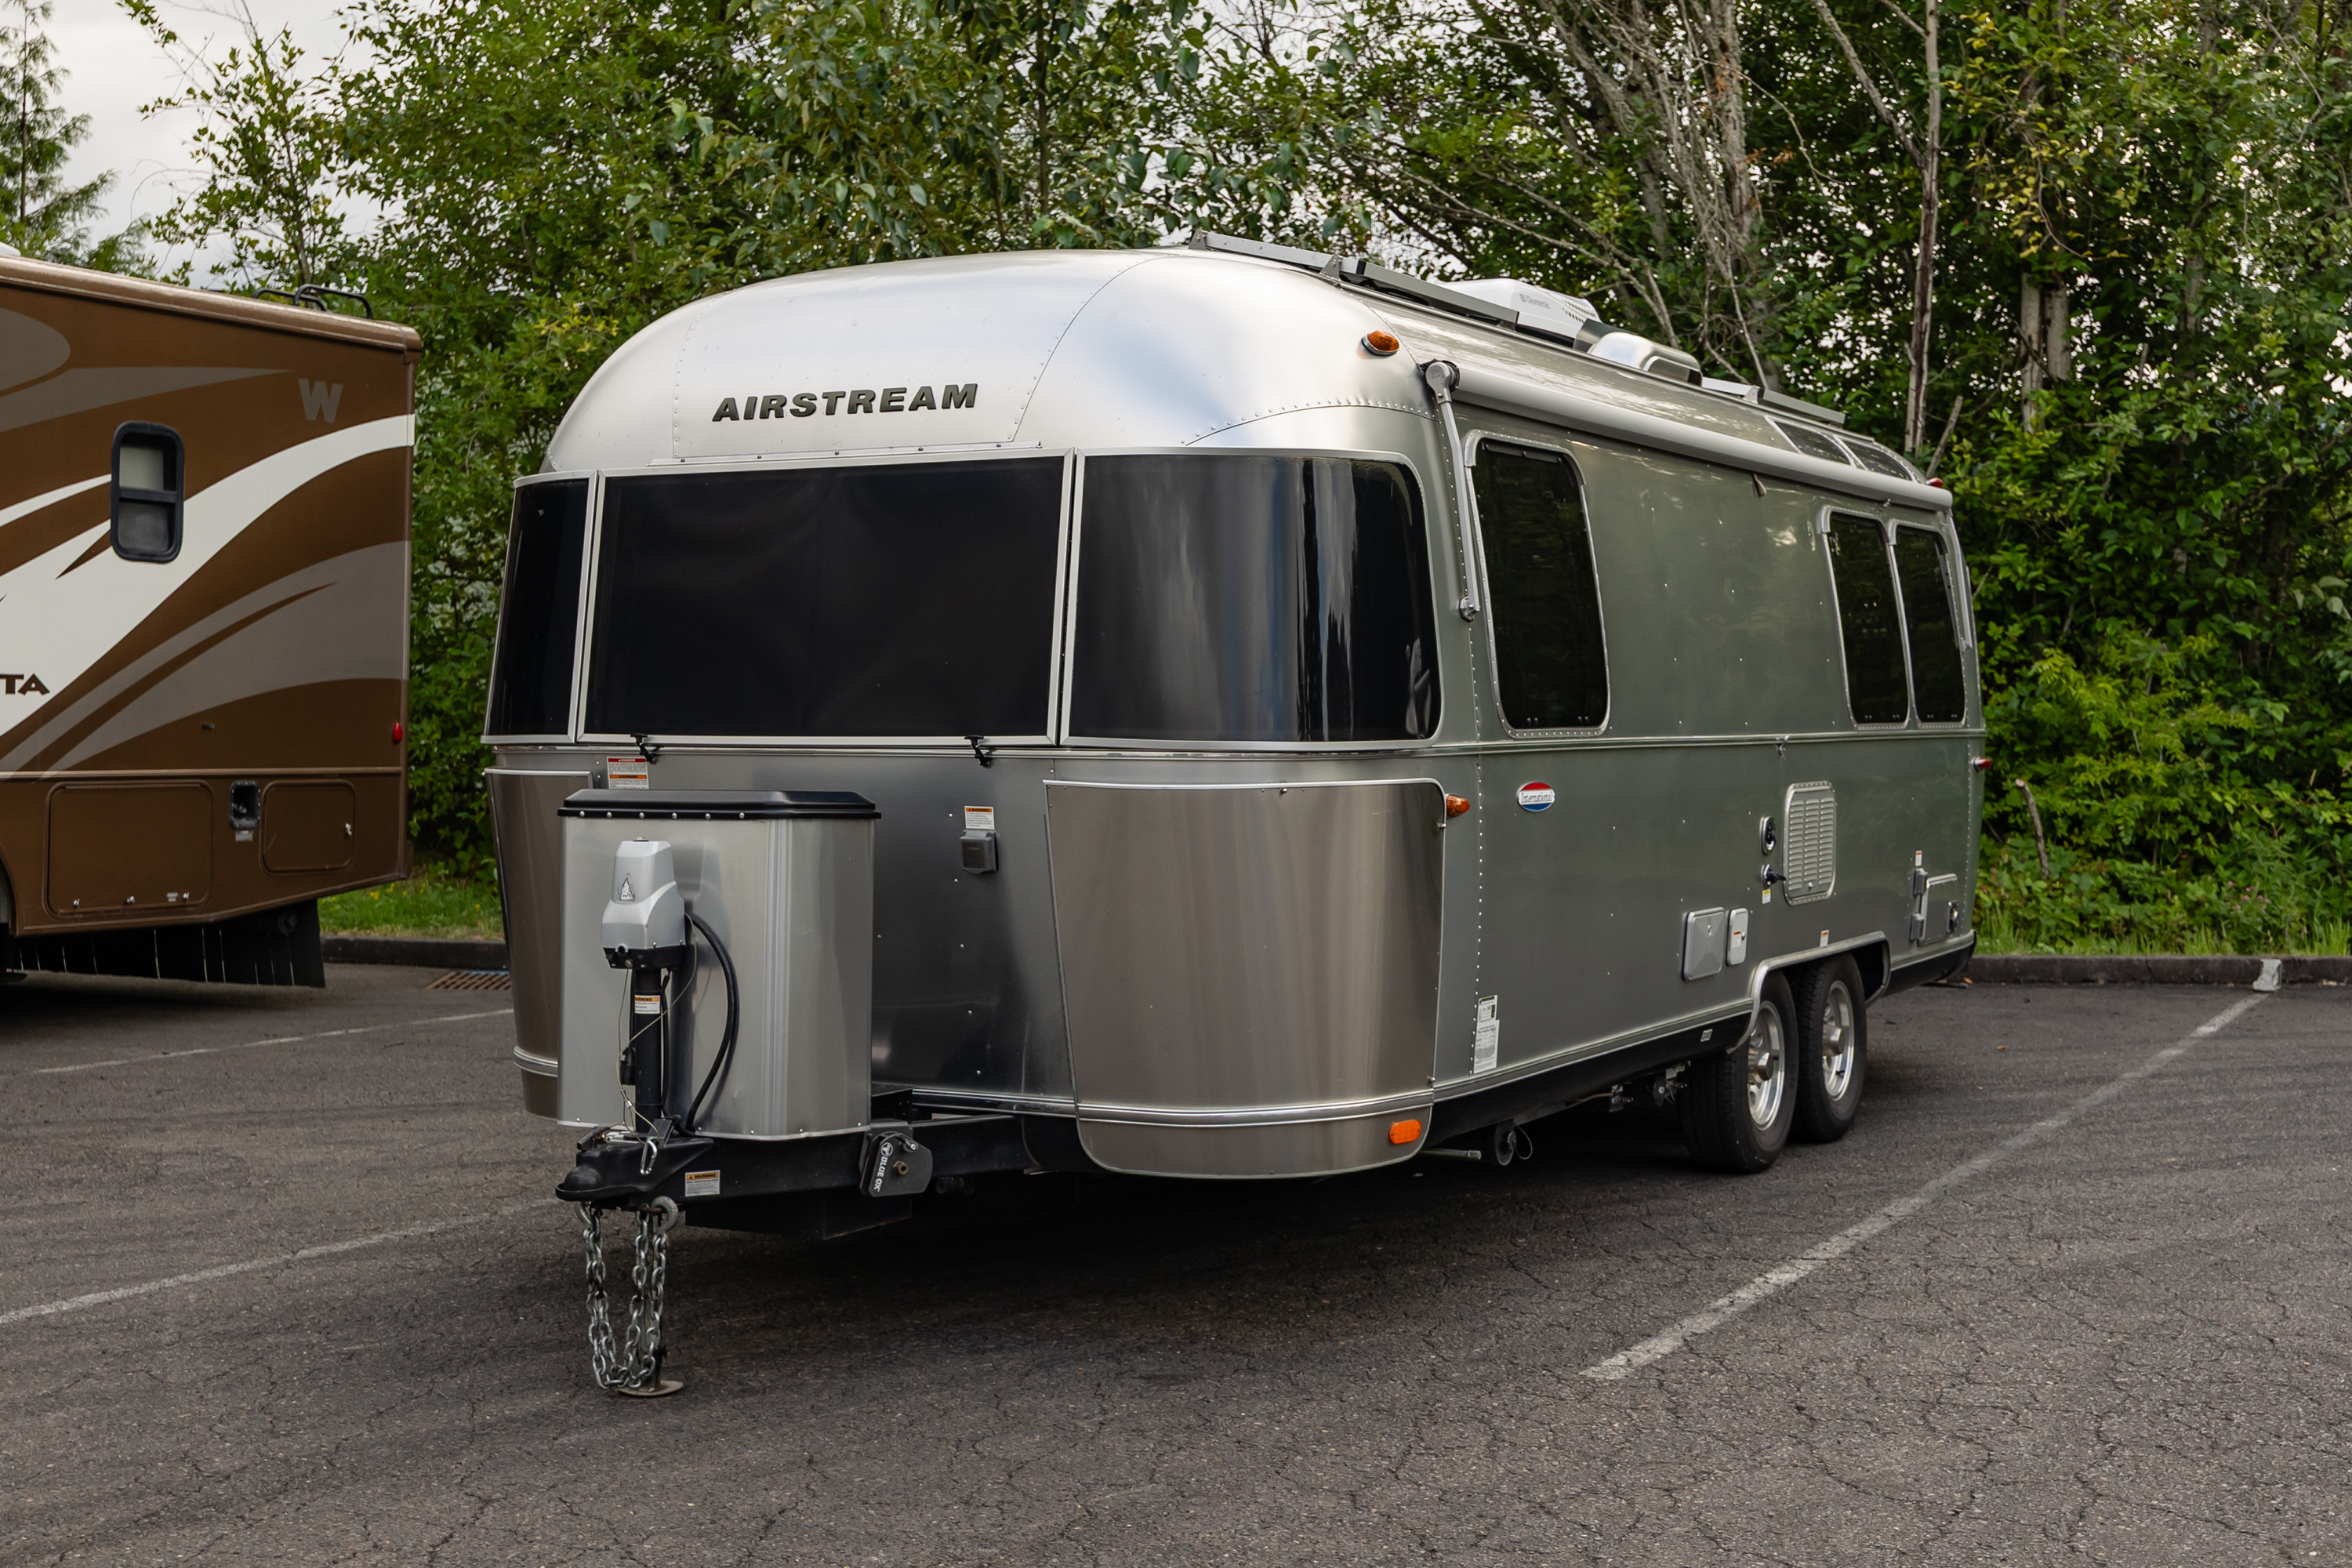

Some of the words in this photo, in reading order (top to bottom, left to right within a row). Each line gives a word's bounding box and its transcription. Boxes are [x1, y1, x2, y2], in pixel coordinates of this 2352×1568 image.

[1526, 295, 1551, 310] Dometic
[298, 378, 343, 423] W
[712, 383, 978, 422] AIRSTREAM
[1521, 791, 1553, 804] International
[877, 1156, 888, 1178] BLUE
[873, 1178, 883, 1192] OX
